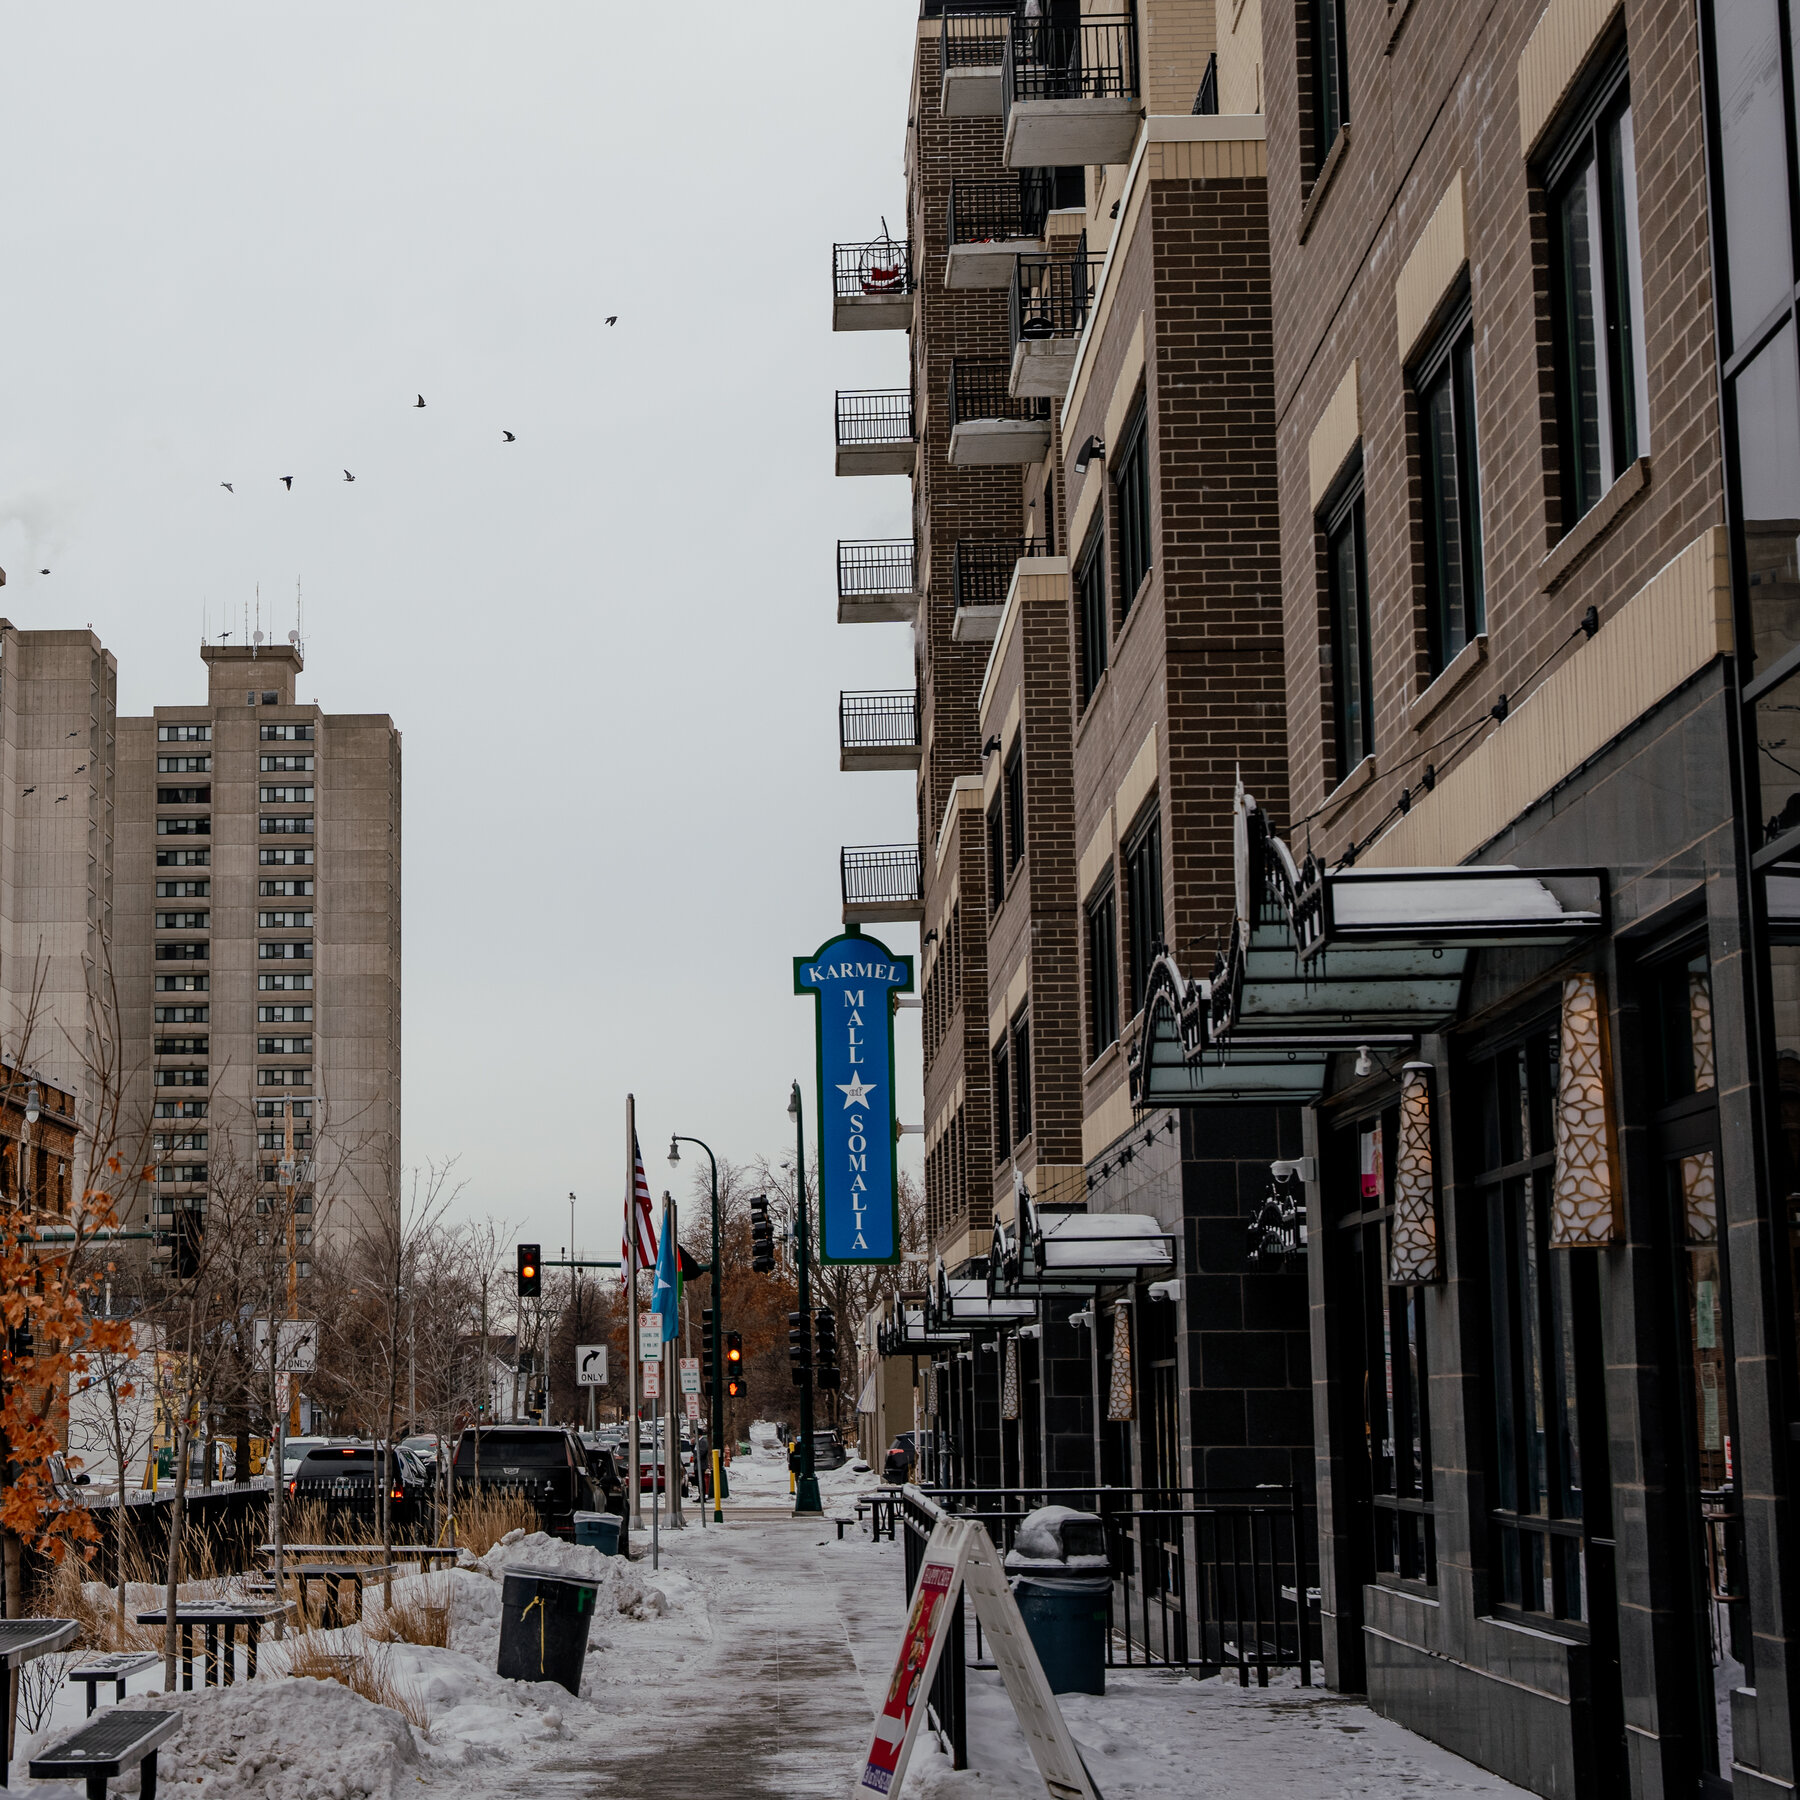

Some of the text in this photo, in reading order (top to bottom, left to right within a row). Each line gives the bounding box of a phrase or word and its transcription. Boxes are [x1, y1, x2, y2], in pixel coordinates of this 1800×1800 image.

[809, 962, 900, 982] KARMEL
[843, 989, 865, 1064] MALL
[849, 1087, 863, 1096] of
[848, 1114, 868, 1250] SOMALIA
[288, 1359, 312, 1368] ONLY
[581, 1373, 604, 1382] ONLY
